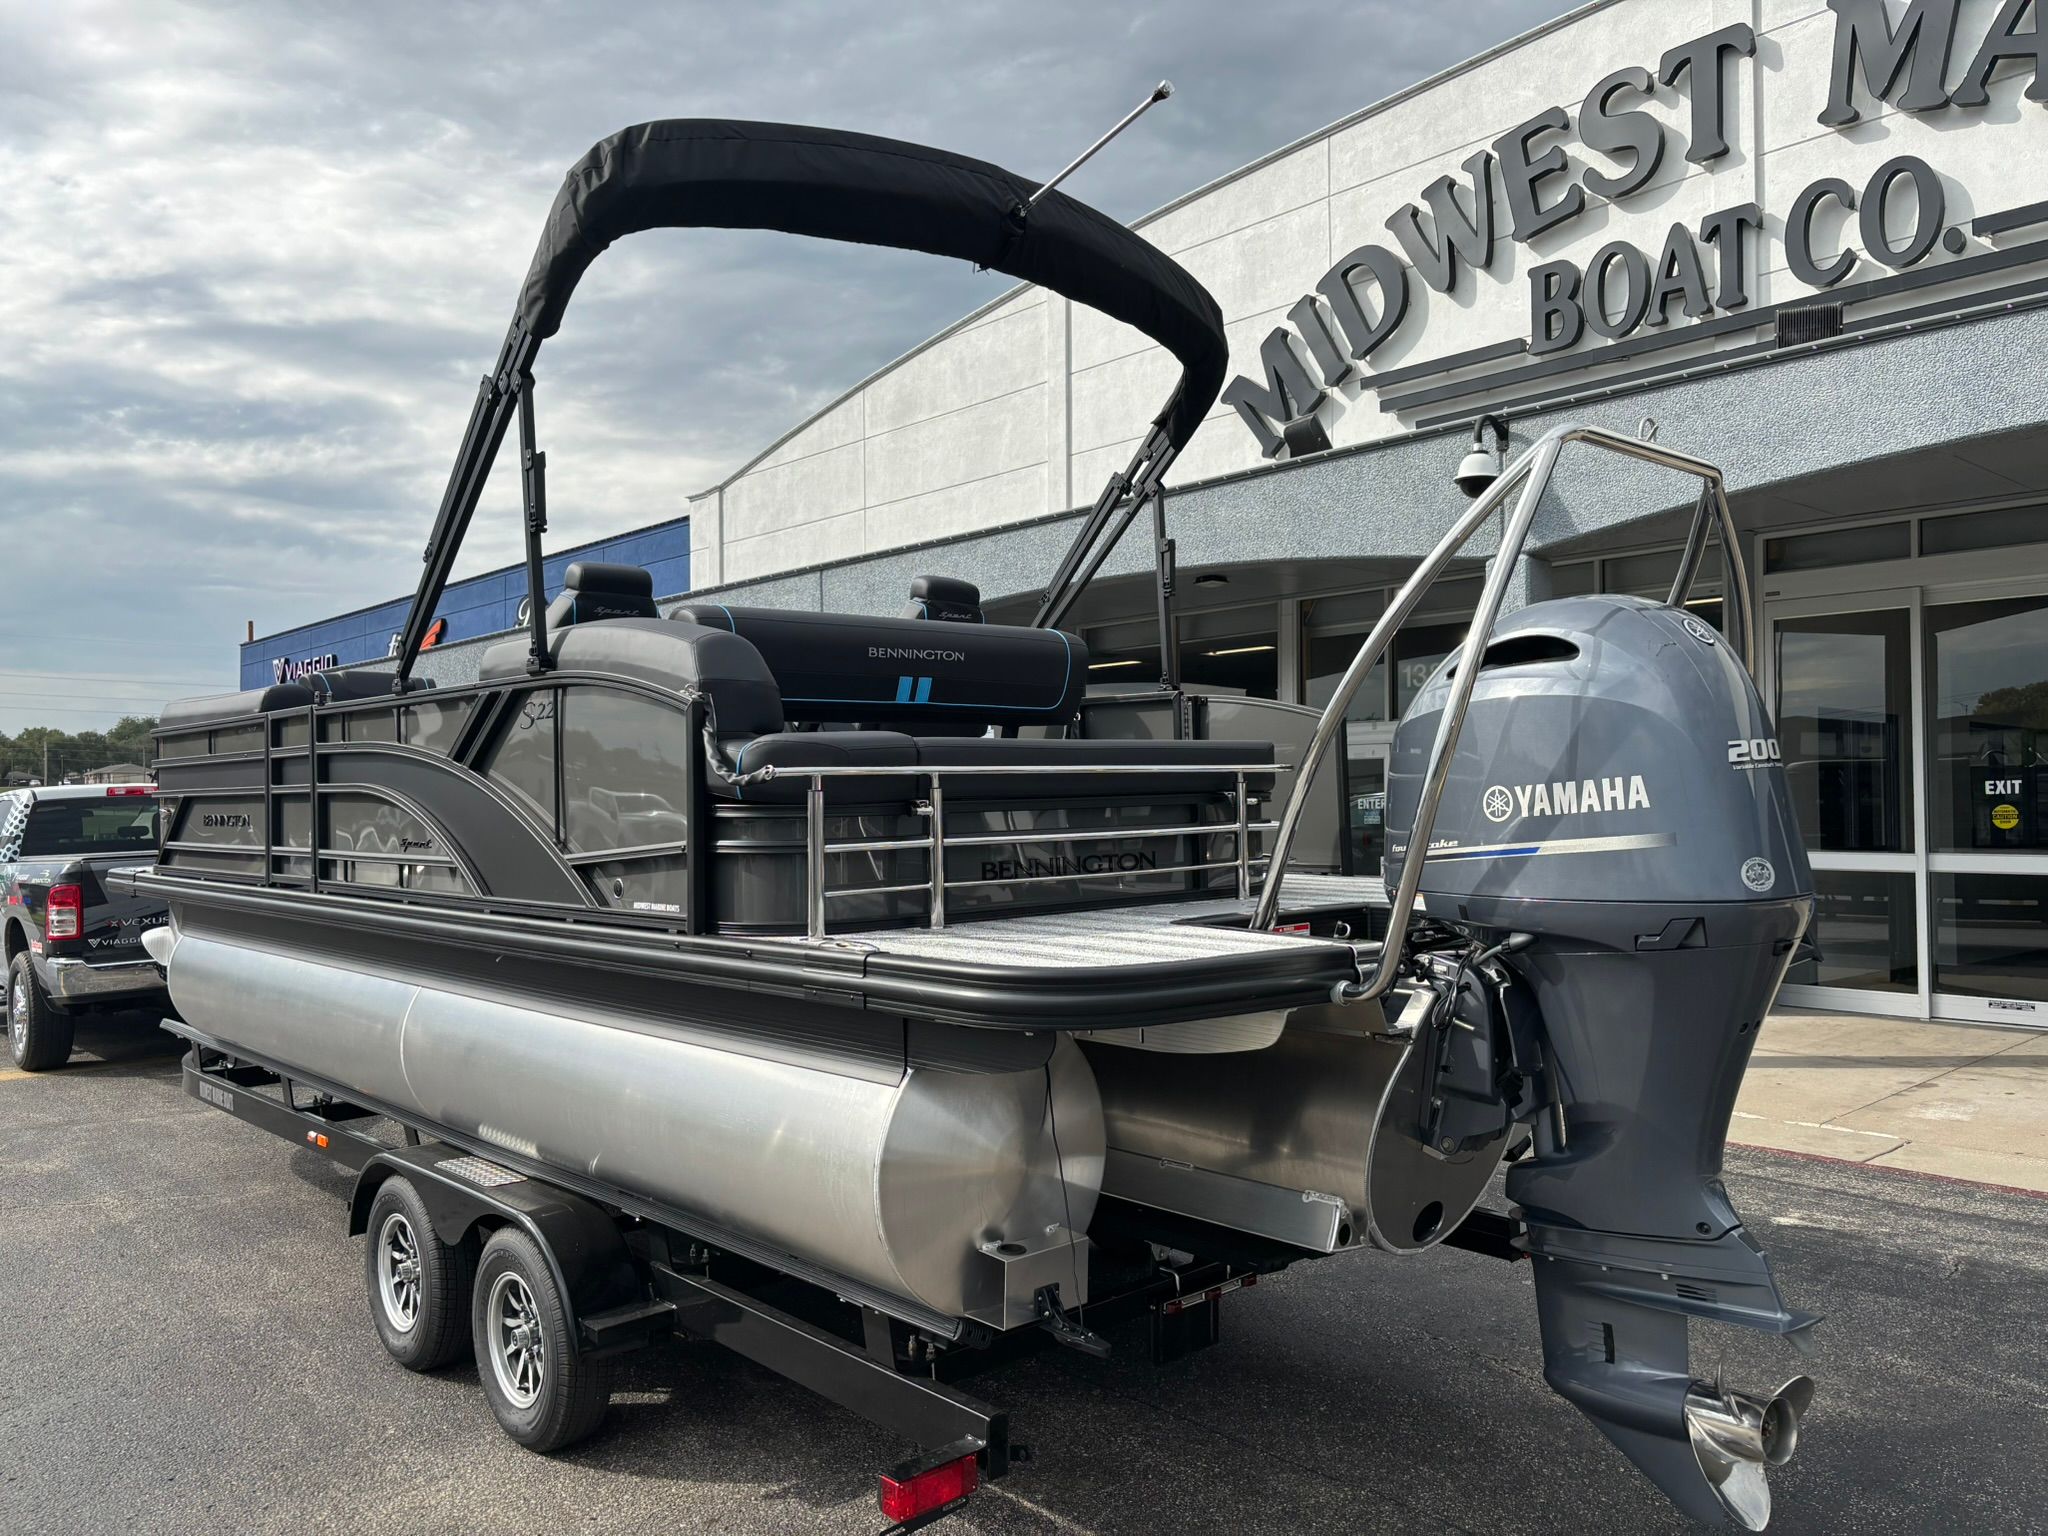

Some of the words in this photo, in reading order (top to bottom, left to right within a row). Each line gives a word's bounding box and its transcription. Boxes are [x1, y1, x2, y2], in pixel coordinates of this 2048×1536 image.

[1220, 22, 1756, 460] MIDWEST
[1528, 202, 1763, 356] BOAT
[1784, 155, 1967, 288] CO.
[285, 653, 333, 681] VIAGGIO
[868, 647, 965, 661] BENNINGTON
[1727, 738, 1781, 762] 200
[1514, 774, 1651, 818] YAMAHA
[1984, 779, 2023, 795] EXIT
[1357, 798, 1385, 810] ENTER
[981, 852, 1157, 881] BENNINGTON
